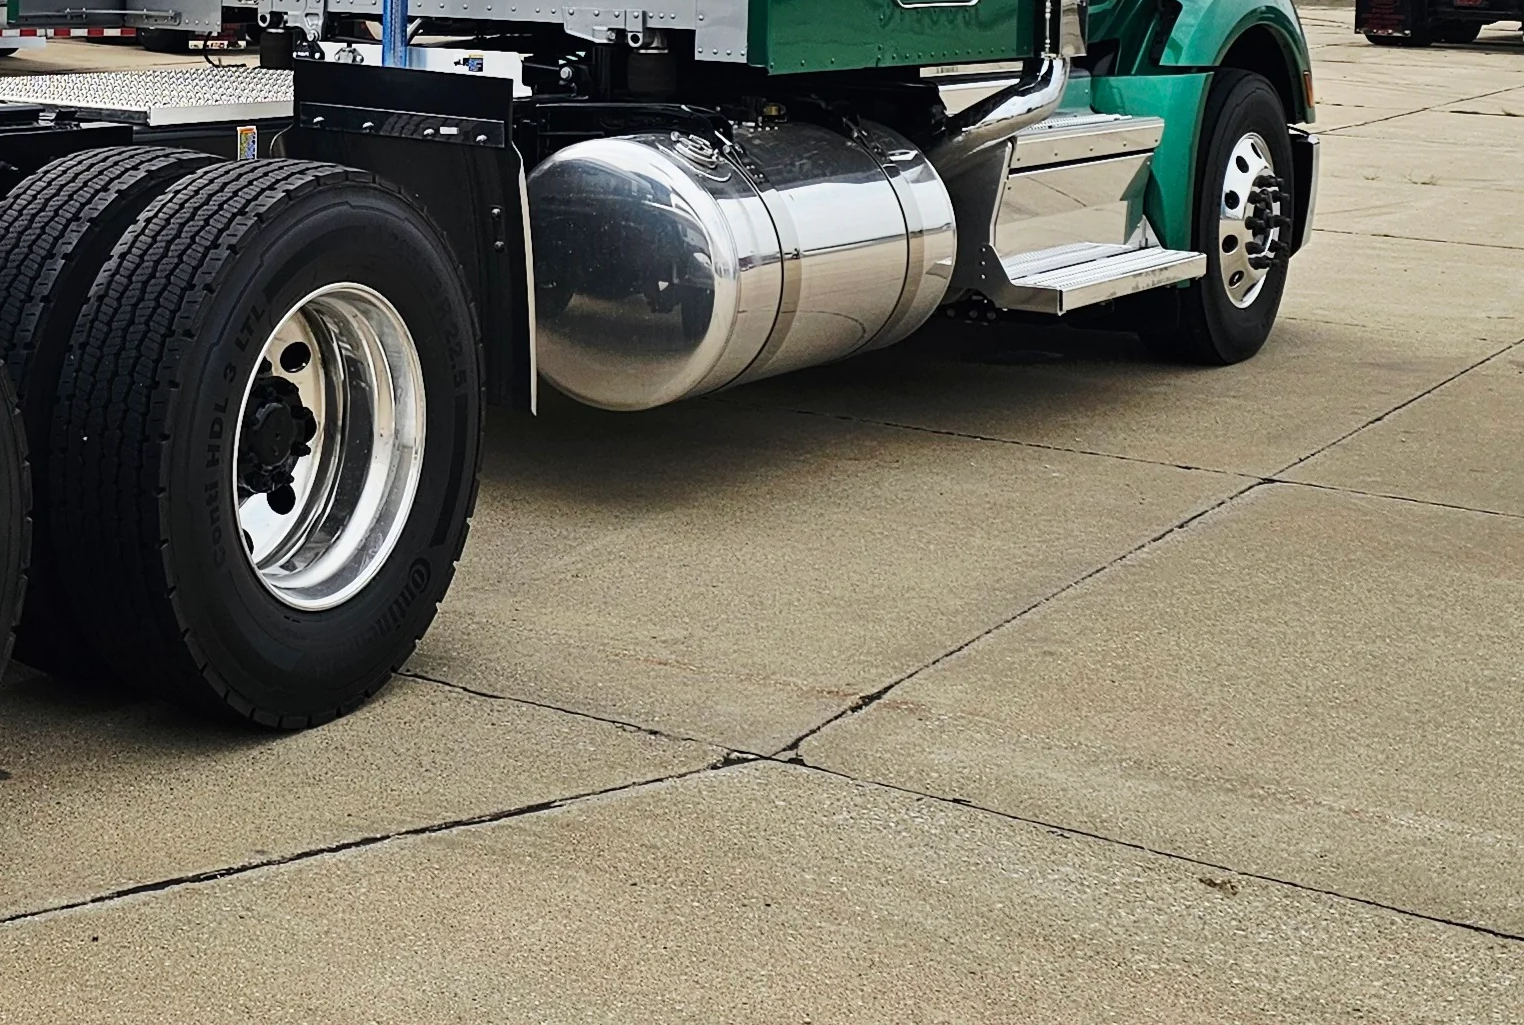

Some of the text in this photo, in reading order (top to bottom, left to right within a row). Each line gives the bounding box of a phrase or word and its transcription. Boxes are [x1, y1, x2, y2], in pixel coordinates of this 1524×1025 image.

[204, 304, 266, 570] Conti HDL 3 LTL
